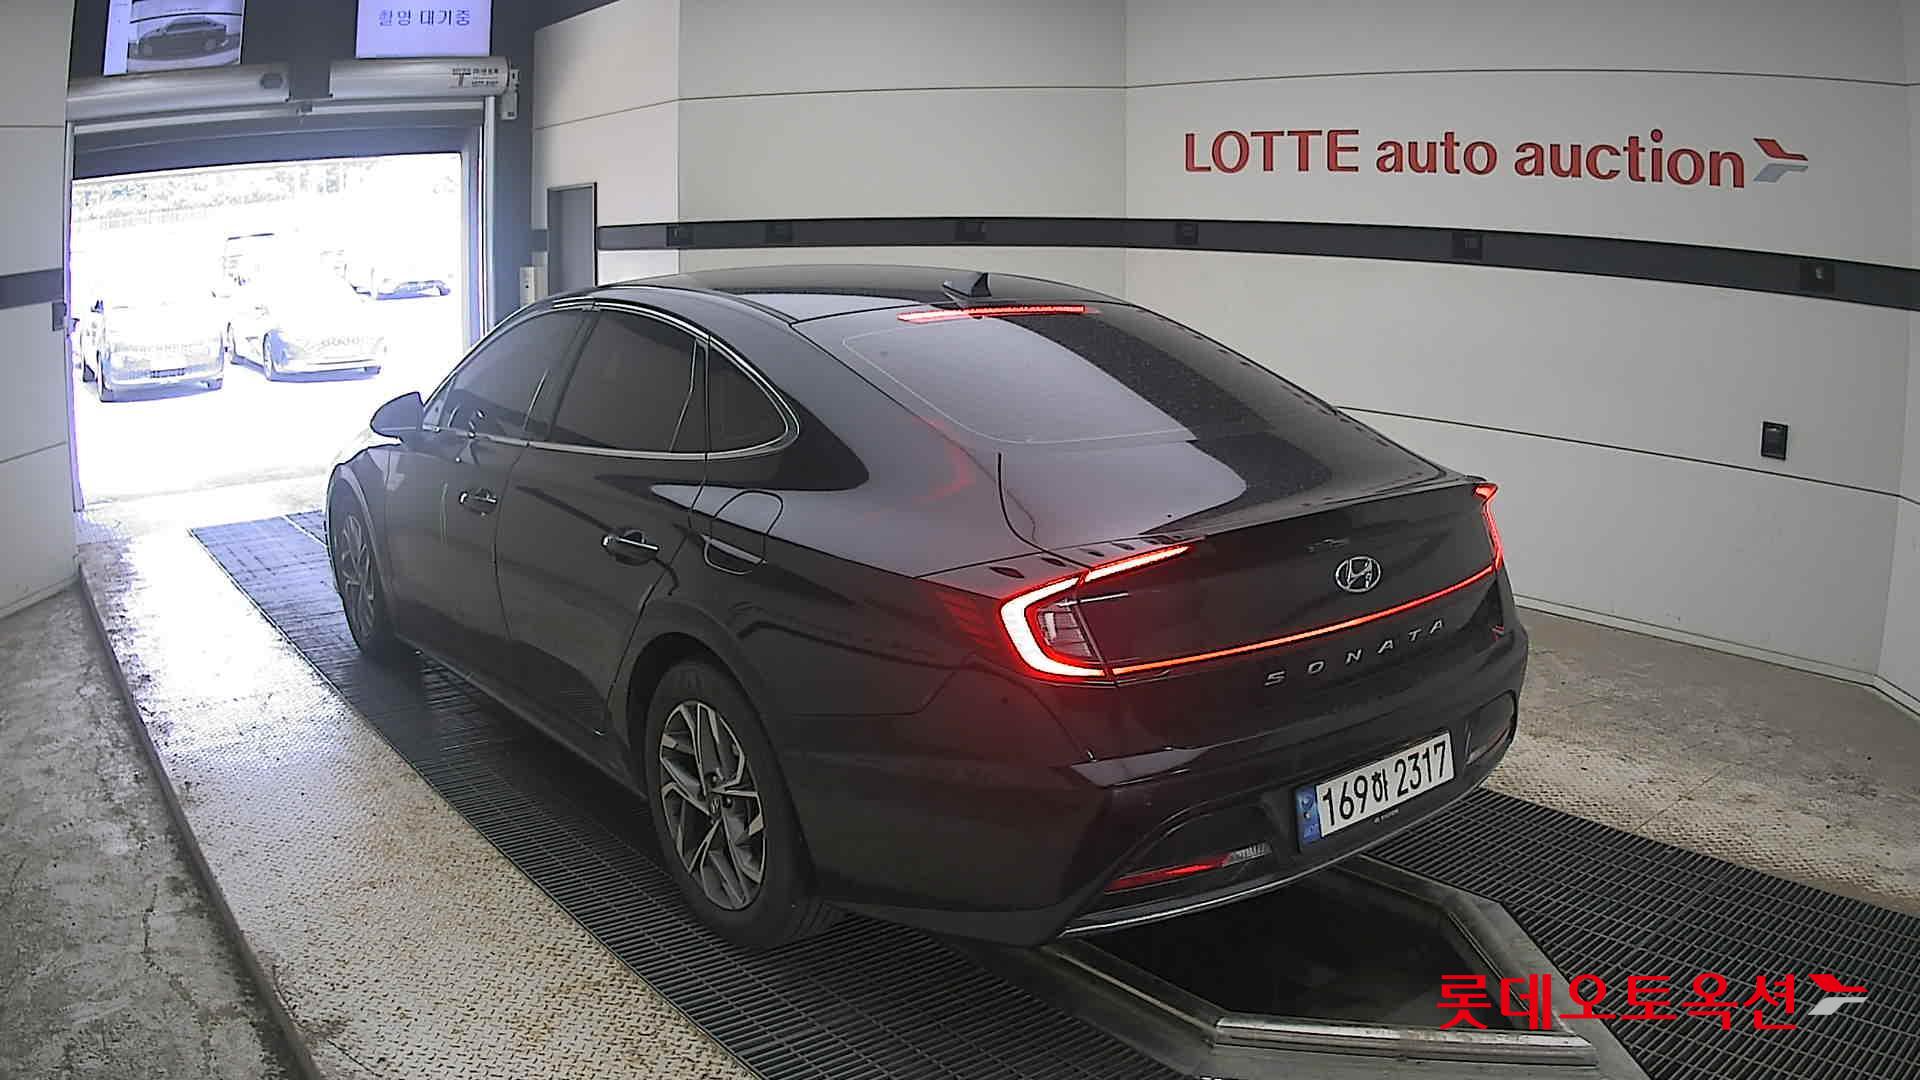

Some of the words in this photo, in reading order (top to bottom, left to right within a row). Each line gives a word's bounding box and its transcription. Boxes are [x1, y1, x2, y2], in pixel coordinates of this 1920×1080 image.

[420, 8, 471, 26] 대기중
[1184, 129, 1360, 174] LOTTE
[1376, 131, 1499, 176] auto
[1513, 128, 1746, 189] auction
[1264, 618, 1444, 686] SONATA
[1322, 768, 1389, 827] 169하
[1394, 740, 1446, 798] 2317
